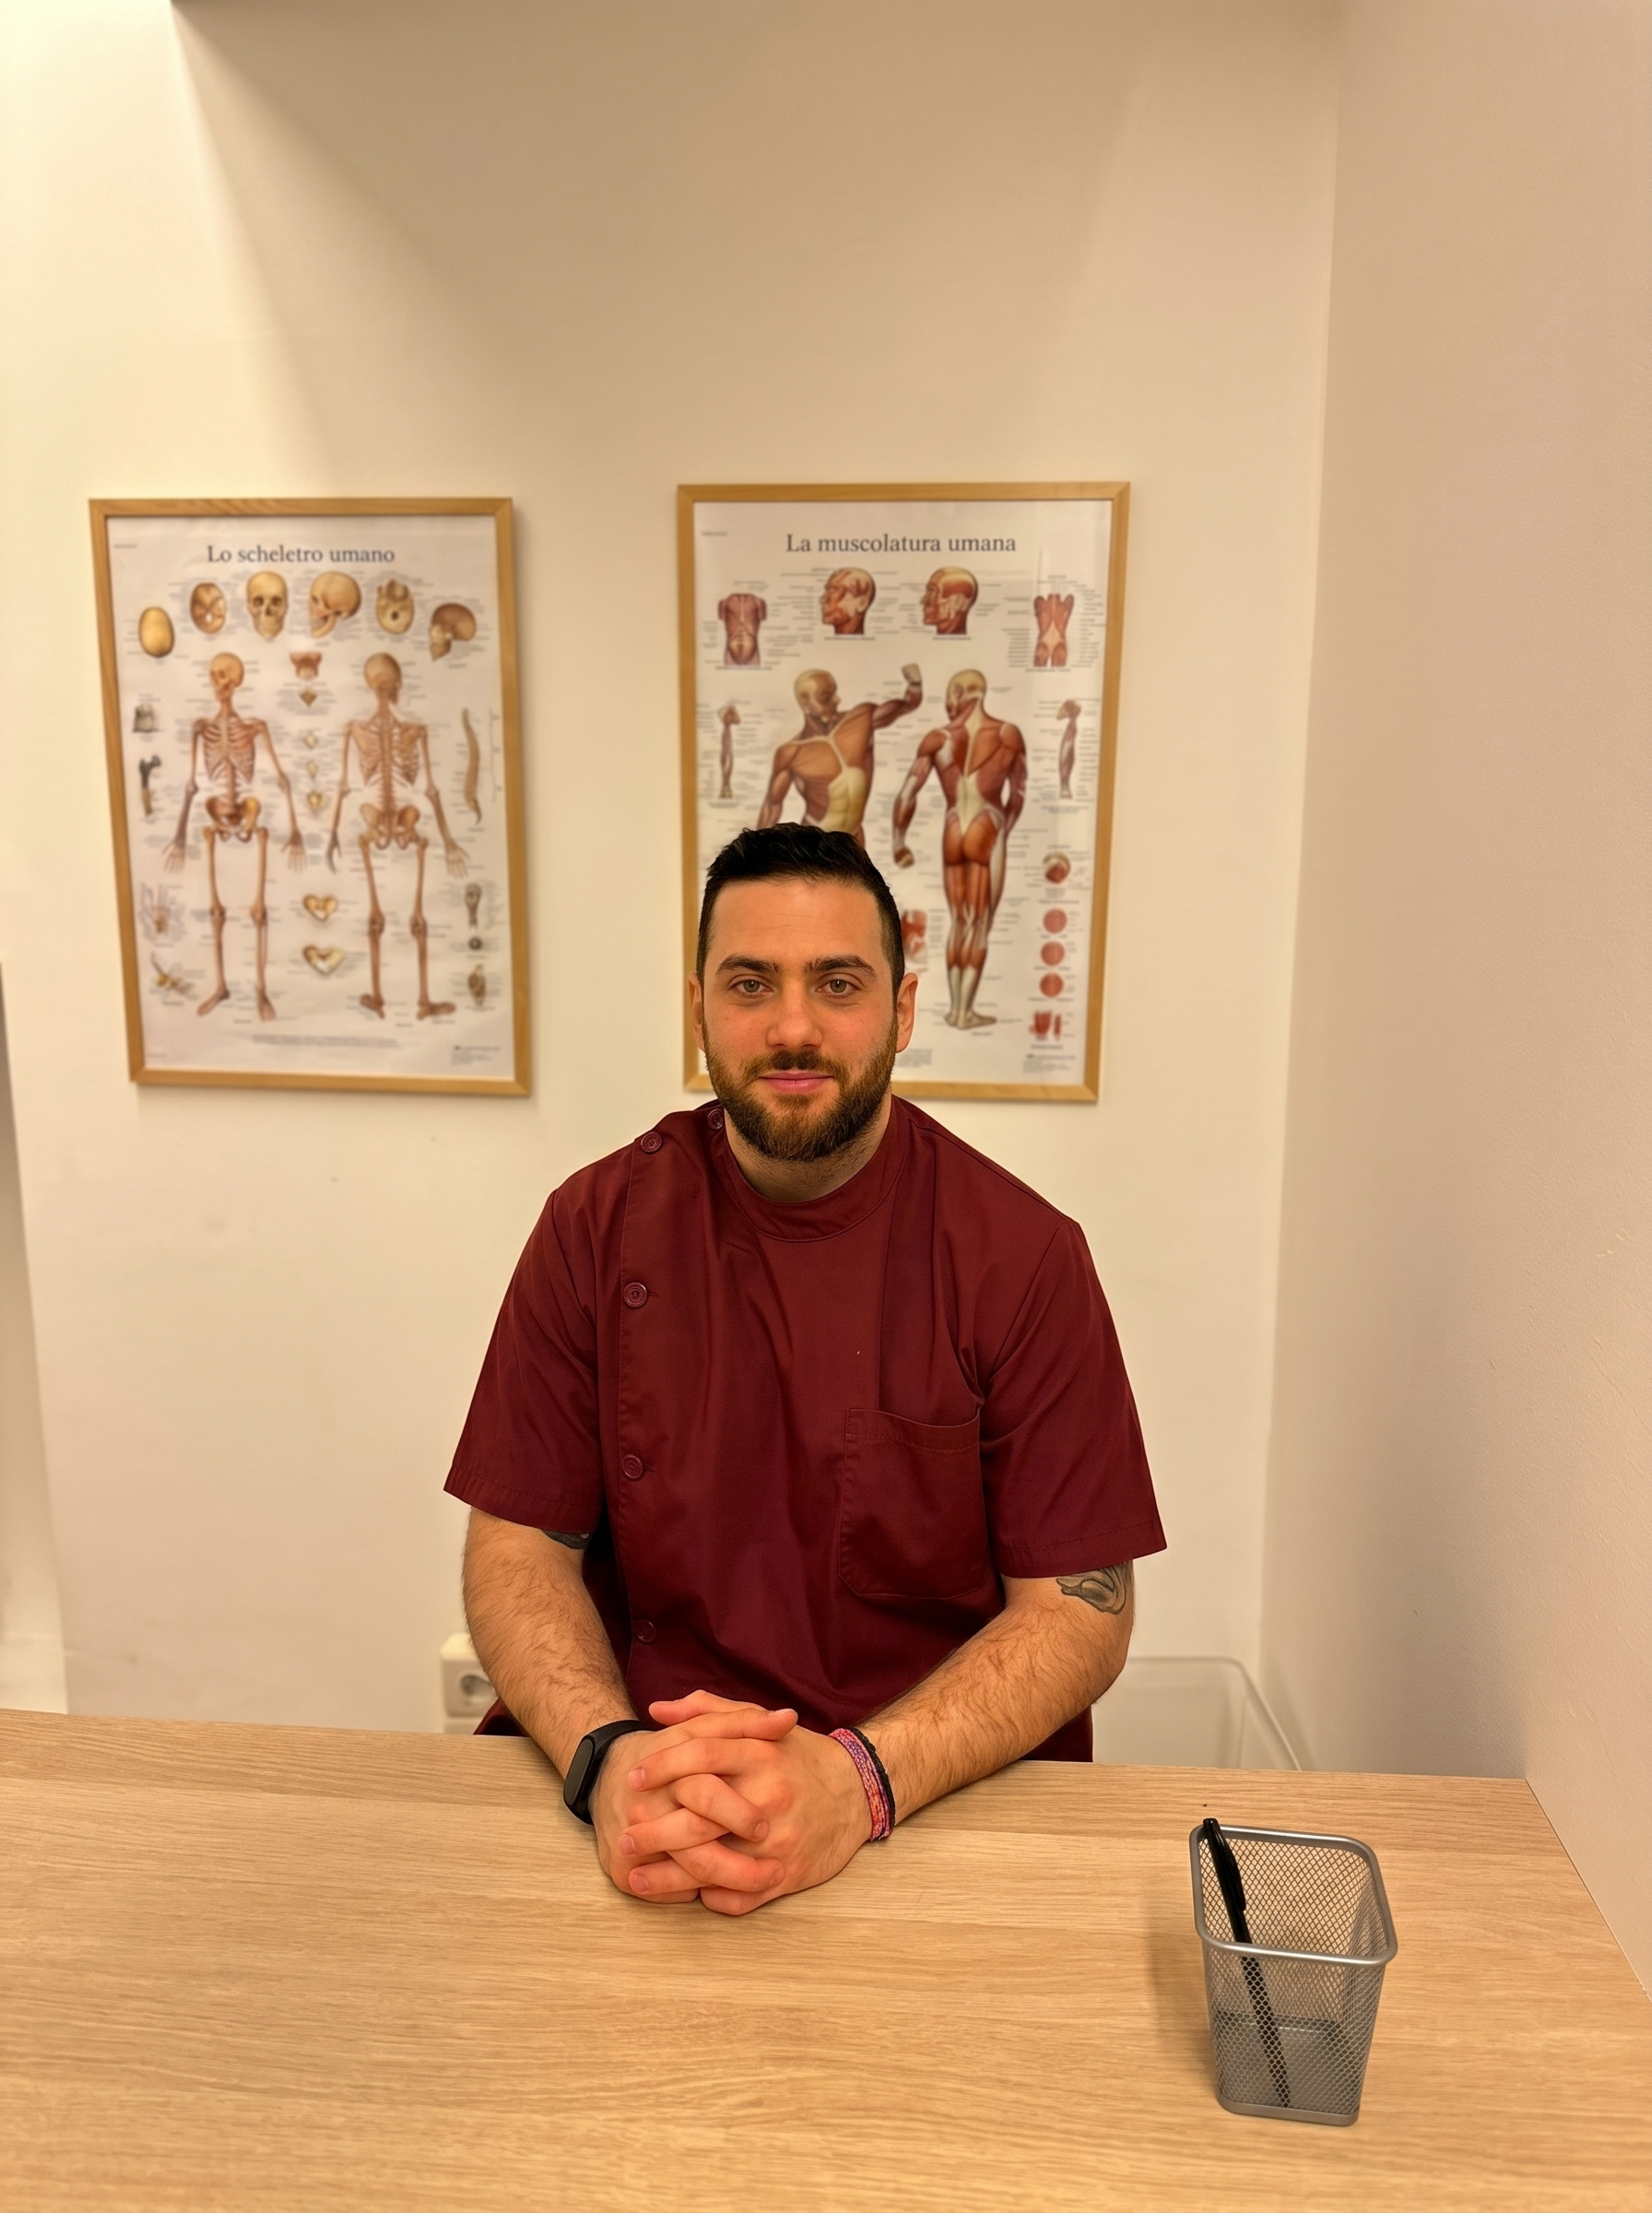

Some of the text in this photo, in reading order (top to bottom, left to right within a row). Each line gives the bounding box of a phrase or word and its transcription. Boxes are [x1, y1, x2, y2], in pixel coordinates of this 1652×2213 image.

[786, 533, 1016, 551] La muscolatura umana
[207, 544, 395, 562] Lo scheletro umano
